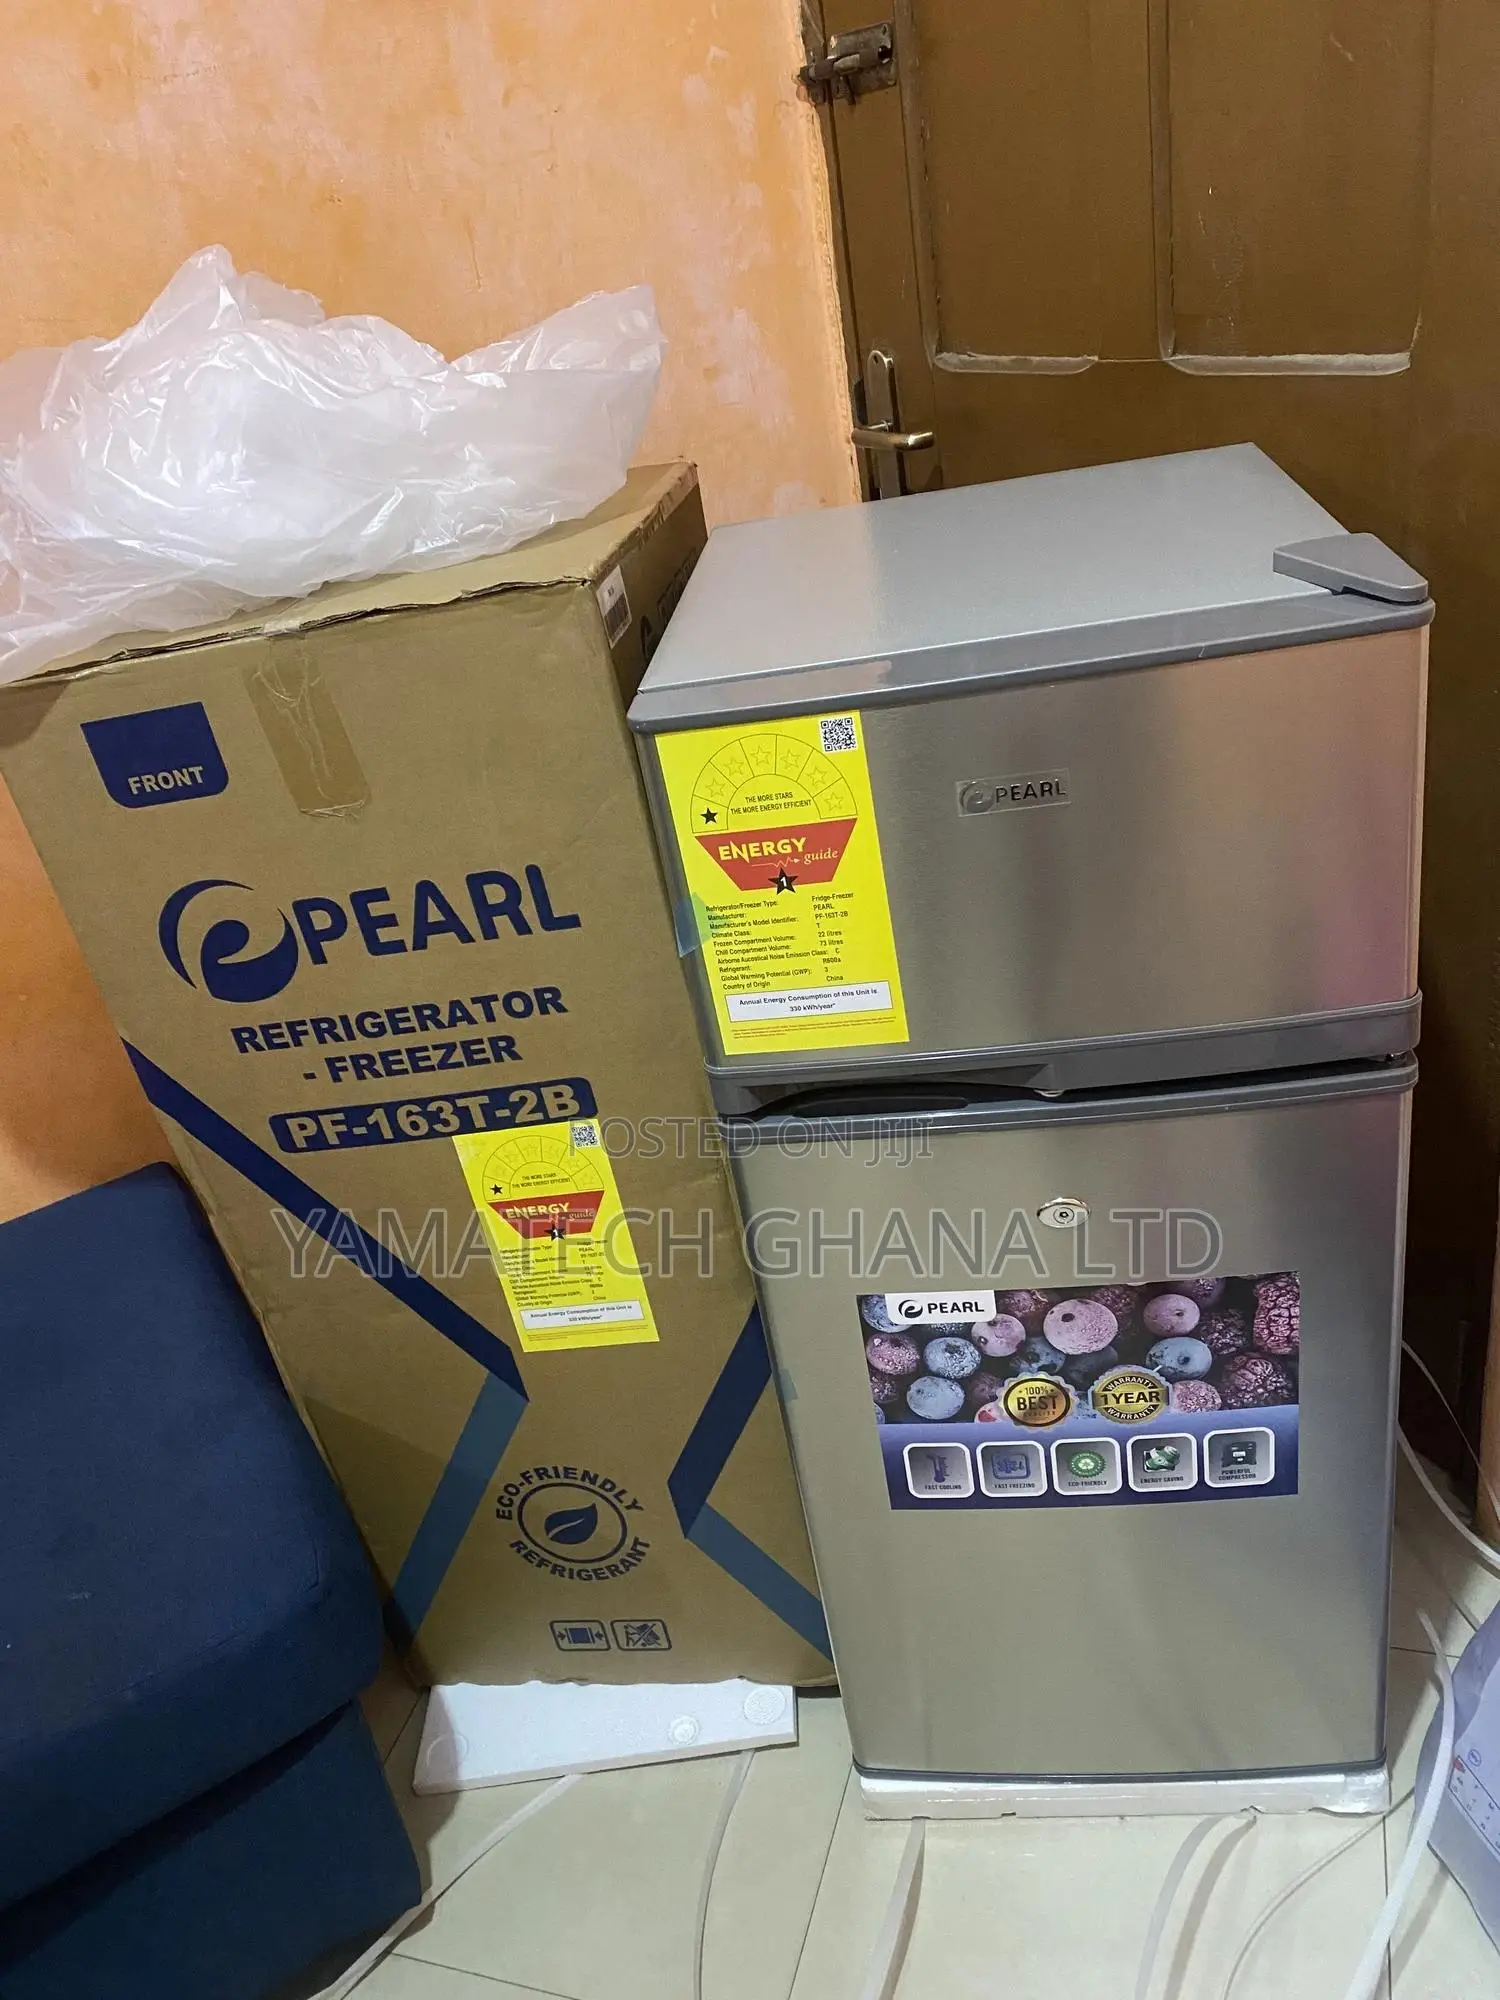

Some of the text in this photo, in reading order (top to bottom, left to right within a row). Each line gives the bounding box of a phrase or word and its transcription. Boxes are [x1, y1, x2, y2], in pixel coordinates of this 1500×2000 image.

[128, 765, 204, 796] FRONT
[757, 794, 774, 802] MORE
[775, 792, 793, 800] STARS
[996, 779, 1066, 803] PEARL
[760, 804, 782, 812] ENERGY
[784, 800, 812, 808] EFFICIENT
[718, 837, 806, 864] ENERGY
[804, 848, 838, 864] guide
[780, 877, 786, 886] 1
[812, 892, 854, 902] Fridge-Freezer
[706, 900, 778, 912] Refrigerator/Freezer Type:
[813, 903, 834, 911] PEARL
[292, 864, 582, 966] PEARL
[814, 910, 848, 920] PF-163T-2B
[734, 937, 772, 946] Compartment
[729, 946, 768, 955] Compartment
[786, 949, 810, 958] Emission
[721, 974, 739, 982] Global
[740, 972, 765, 980] Warming
[766, 970, 791, 978] Potential
[753, 980, 771, 988] Origin
[739, 998, 762, 1006] Annual
[764, 996, 786, 1004] Energy
[788, 992, 832, 1002] Consumption
[230, 985, 569, 1054] REFRIGERATOR
[303, 1034, 522, 1084] - FREEZER
[285, 1083, 581, 1149] PF-163T-2B
[506, 1202, 570, 1220] ENERGY
[569, 1209, 595, 1222] guide
[927, 1299, 984, 1316] PEARL
[1026, 1386, 1048, 1394] 100%
[1107, 1376, 1155, 1391] WARRANTY
[1017, 1395, 1058, 1410] BEST
[1101, 1392, 1160, 1406] 1 YEAR
[1106, 1406, 1155, 1420] WARRANTY
[496, 1466, 644, 1520] ECO-FRIENDLY
[510, 1536, 650, 1580] REFRIGERANT
